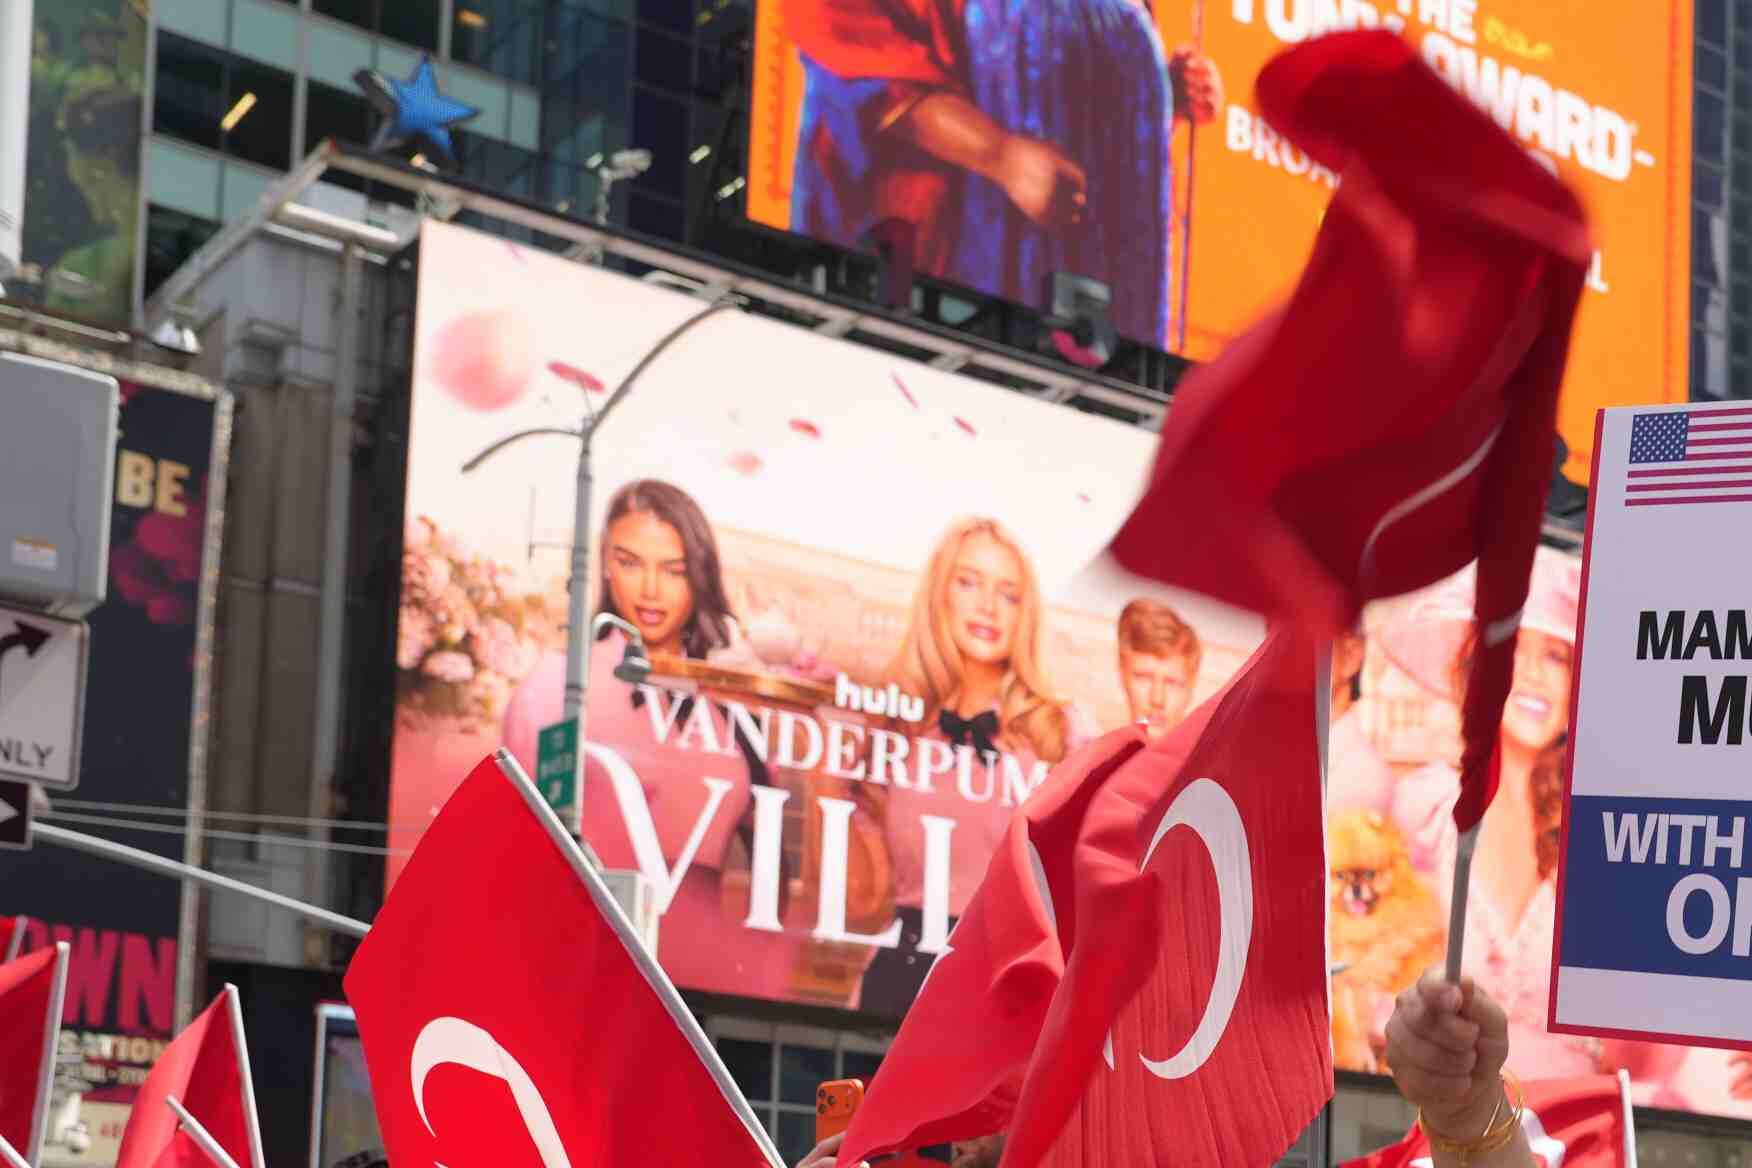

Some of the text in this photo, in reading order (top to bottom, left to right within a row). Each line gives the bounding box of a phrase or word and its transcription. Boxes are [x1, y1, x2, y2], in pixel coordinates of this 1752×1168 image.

[835, 672, 926, 722] hulu
[0, 738, 55, 768] NLY
[637, 682, 1049, 809] VANDERPUM
[583, 740, 958, 955] VILL
[1602, 811, 1746, 870] WITH
